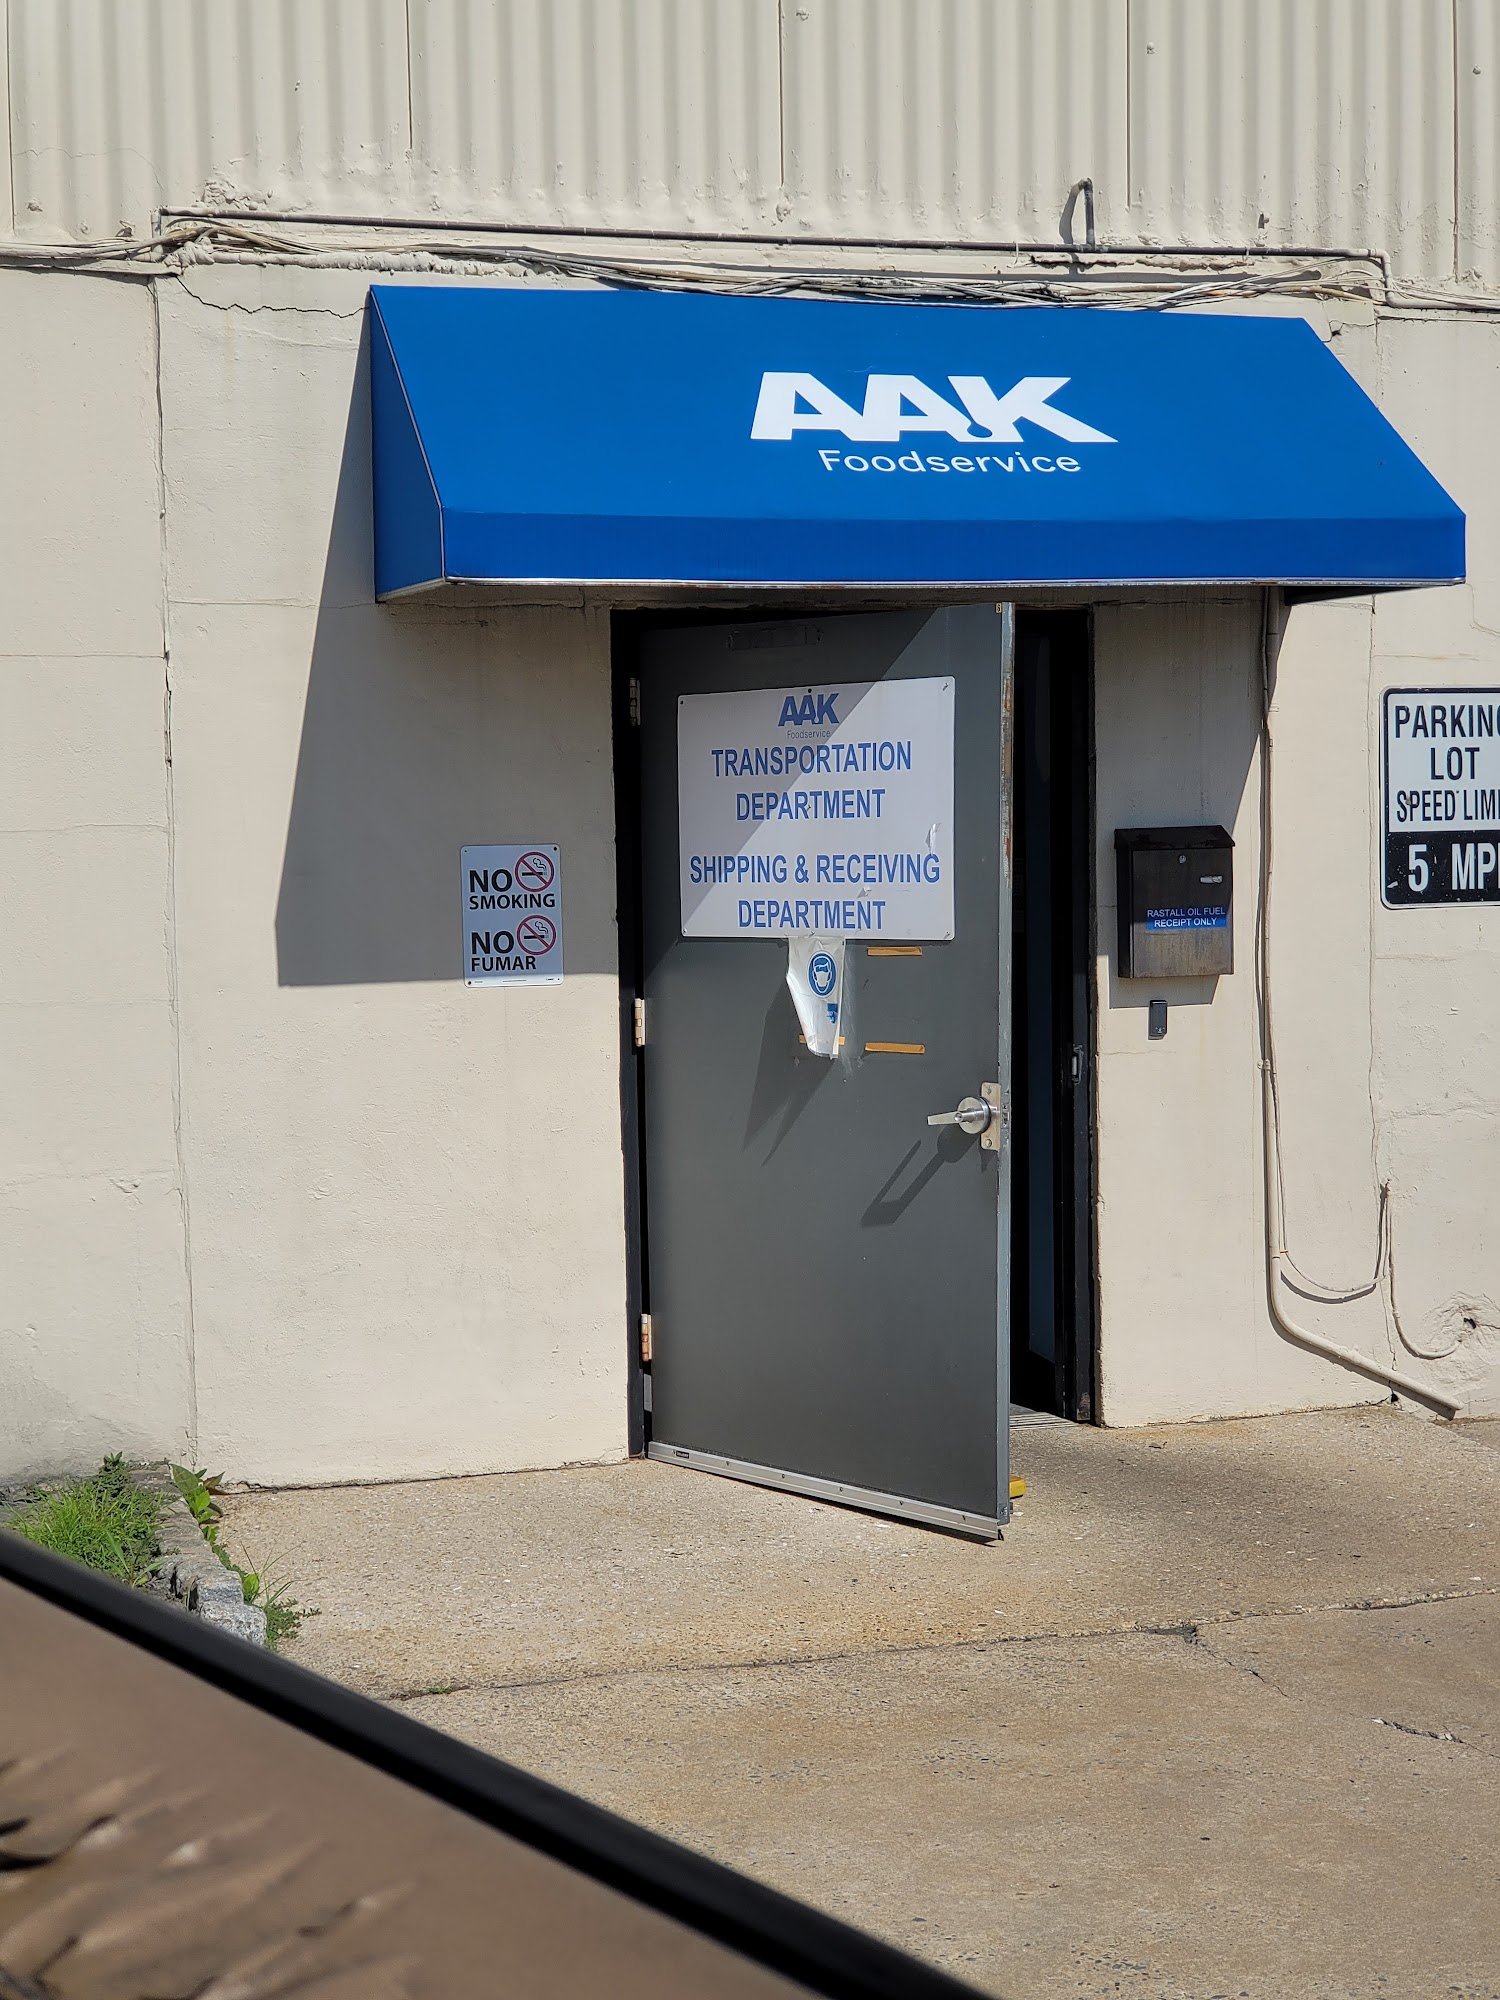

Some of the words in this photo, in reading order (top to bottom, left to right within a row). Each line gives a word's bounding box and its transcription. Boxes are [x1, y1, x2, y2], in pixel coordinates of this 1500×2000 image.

[750, 371, 1119, 443] AAK
[817, 449, 1082, 473] Foodservice
[777, 693, 840, 727] AAK
[1395, 704, 1500, 738] PARKIN
[786, 729, 831, 739] Foodservice
[711, 741, 911, 777] TRANSPORTATION
[1430, 746, 1480, 781] LOT
[736, 788, 886, 821] DEPARTMENT
[1397, 789, 1456, 822] SPEED
[469, 869, 513, 892] NO
[690, 854, 787, 884] SHIPPING
[794, 855, 809, 883] &
[816, 853, 941, 884] RECEIVING
[1408, 844, 1429, 892] 5
[1452, 842, 1500, 890] MP
[469, 893, 556, 910] SMOKING
[738, 900, 886, 930] DEPARTMENT
[1147, 909, 1185, 918] RASTALL
[1187, 908, 1201, 916] OIL
[1204, 907, 1225, 915] FUEL
[1154, 919, 1191, 927] RECEIPT
[1193, 918, 1217, 926] ONLY
[471, 931, 515, 955] NO
[471, 956, 537, 971] FUMAR
